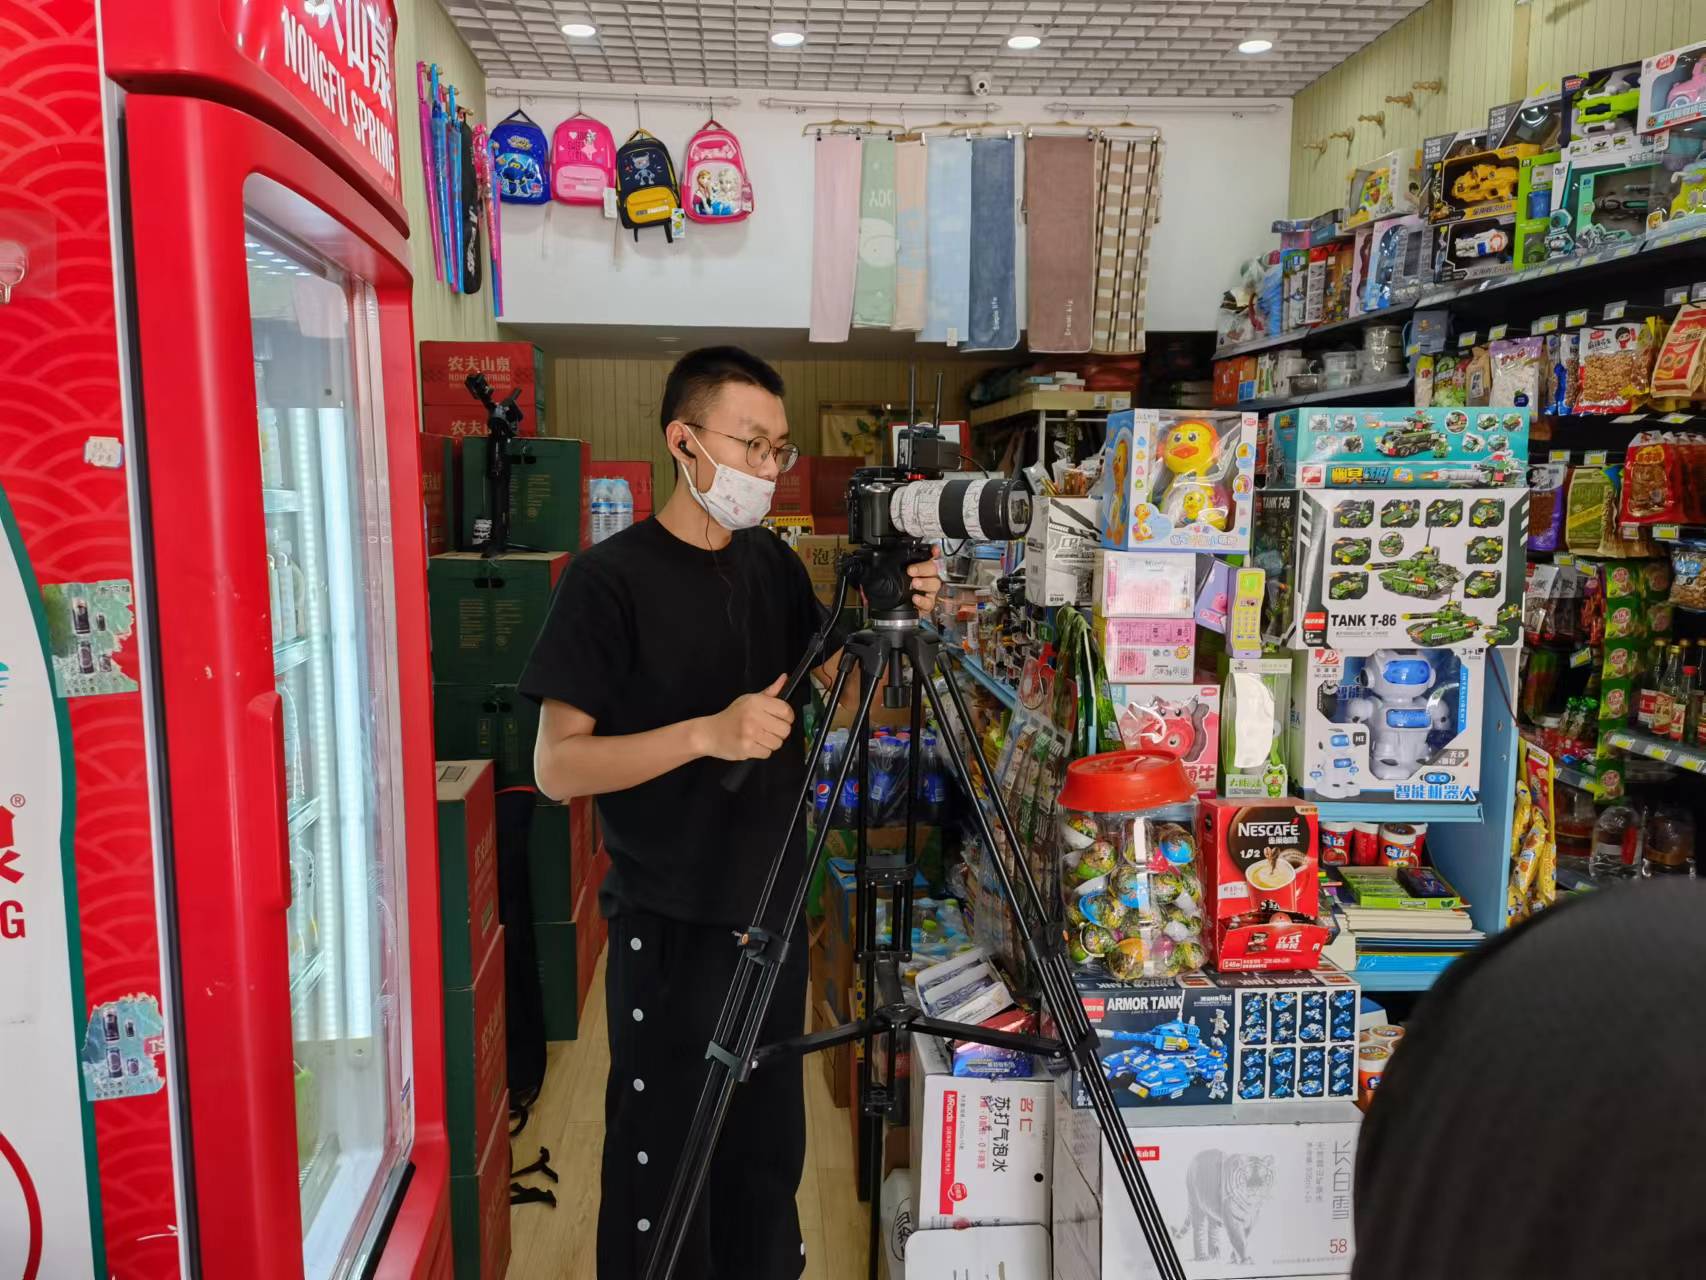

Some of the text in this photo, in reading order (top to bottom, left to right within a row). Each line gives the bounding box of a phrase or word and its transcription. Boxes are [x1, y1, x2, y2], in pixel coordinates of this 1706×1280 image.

[281, 5, 395, 180] NONGFU SPRING
[448, 356, 512, 373] 农夫山泉
[1331, 614, 1397, 627] TANK T-86
[1395, 784, 1476, 801] 智能机器人
[1107, 995, 1182, 1011] ARMOR TANK
[1019, 1097, 1034, 1132] 名仁
[992, 1096, 1011, 1173] 苏打气泡水
[1331, 1140, 1352, 1221] 长白雪
[1329, 1238, 1348, 1254] 58
